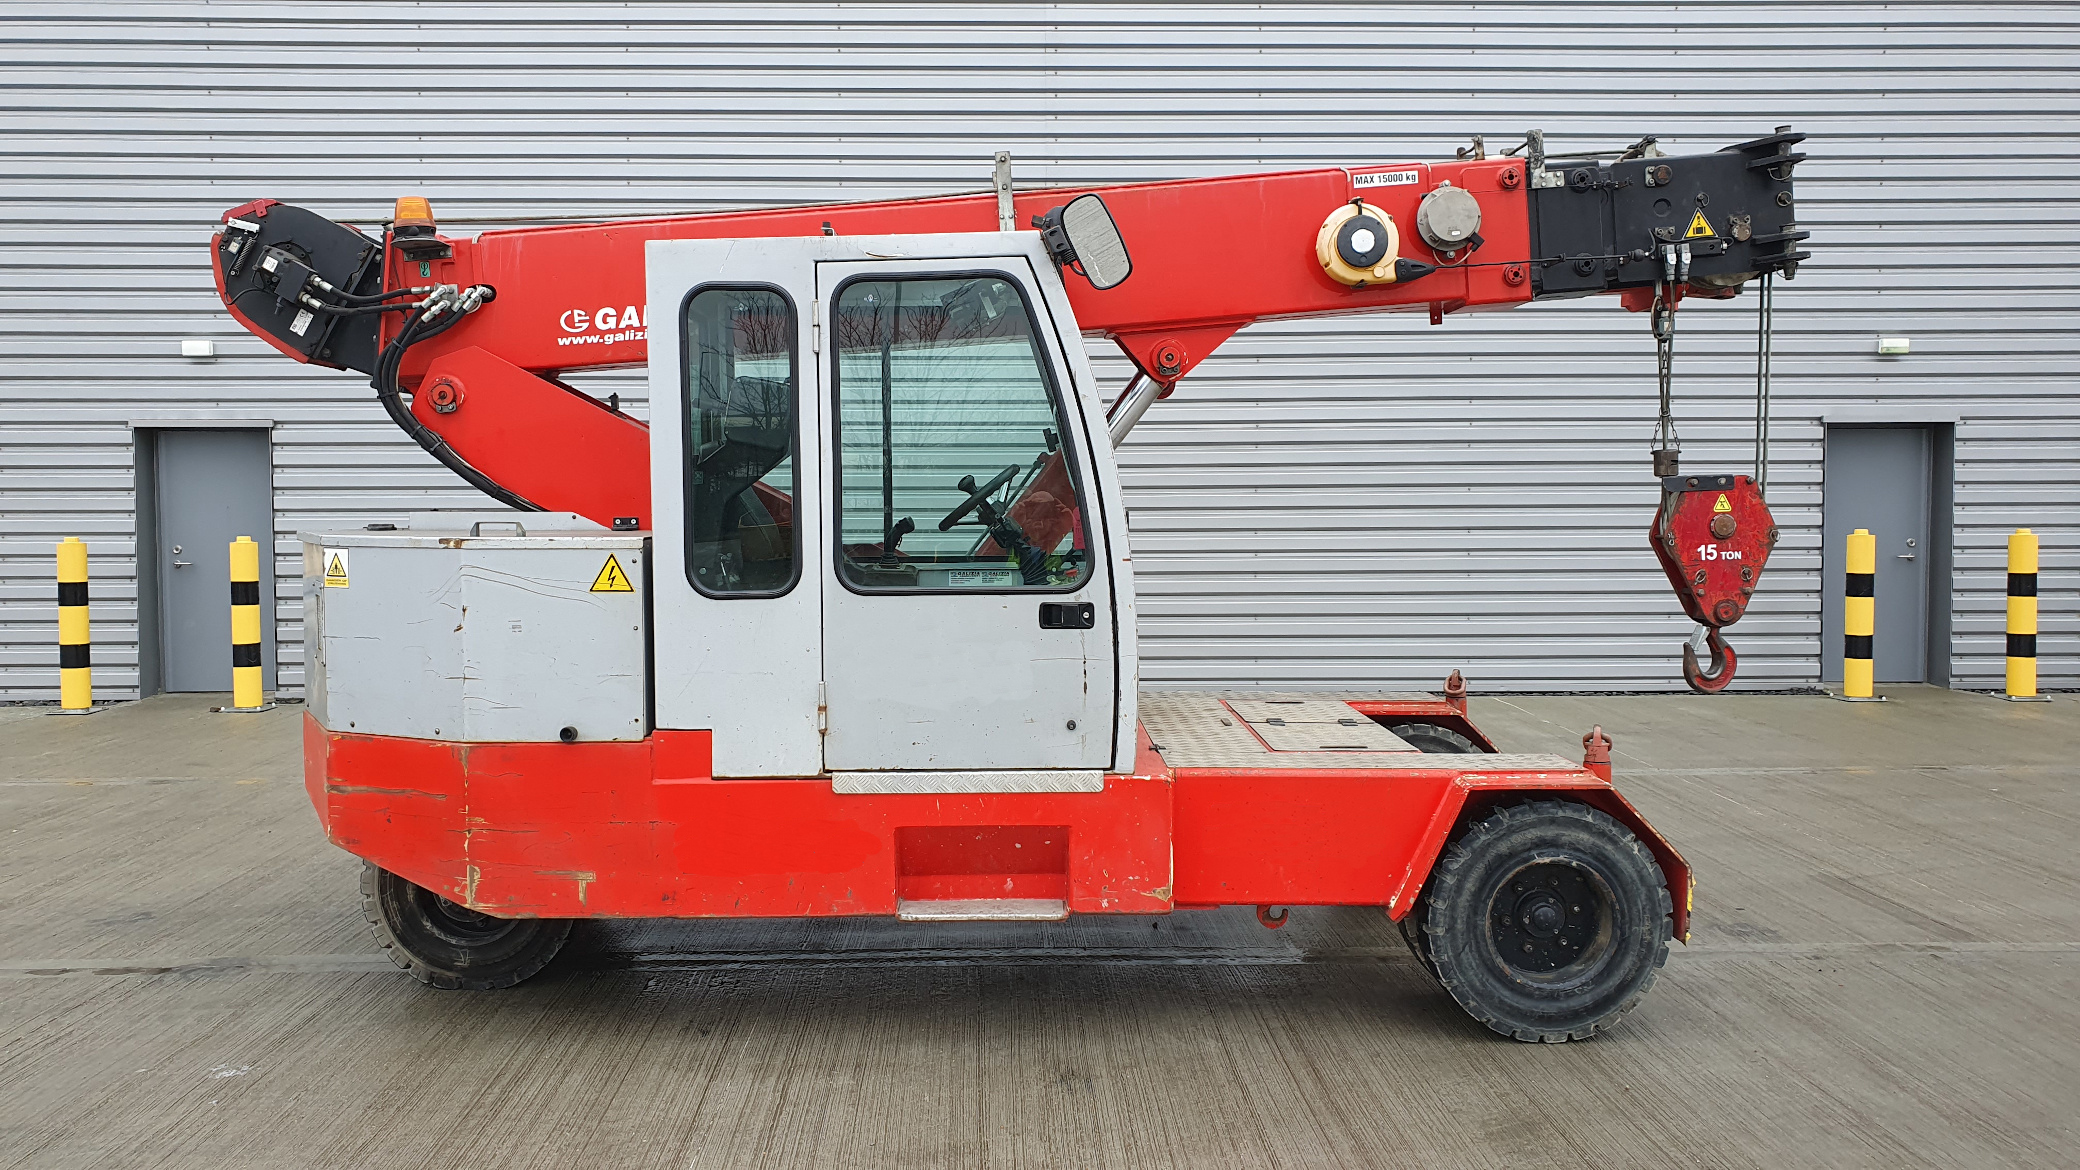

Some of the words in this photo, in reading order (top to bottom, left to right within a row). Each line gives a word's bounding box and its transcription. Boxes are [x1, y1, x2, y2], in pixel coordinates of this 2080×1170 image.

[1355, 176, 1374, 184] MAX
[1378, 173, 1403, 183] 15000
[1406, 173, 1416, 182] kg
[1697, 544, 1718, 561] 15
[1720, 551, 1742, 560] TON
